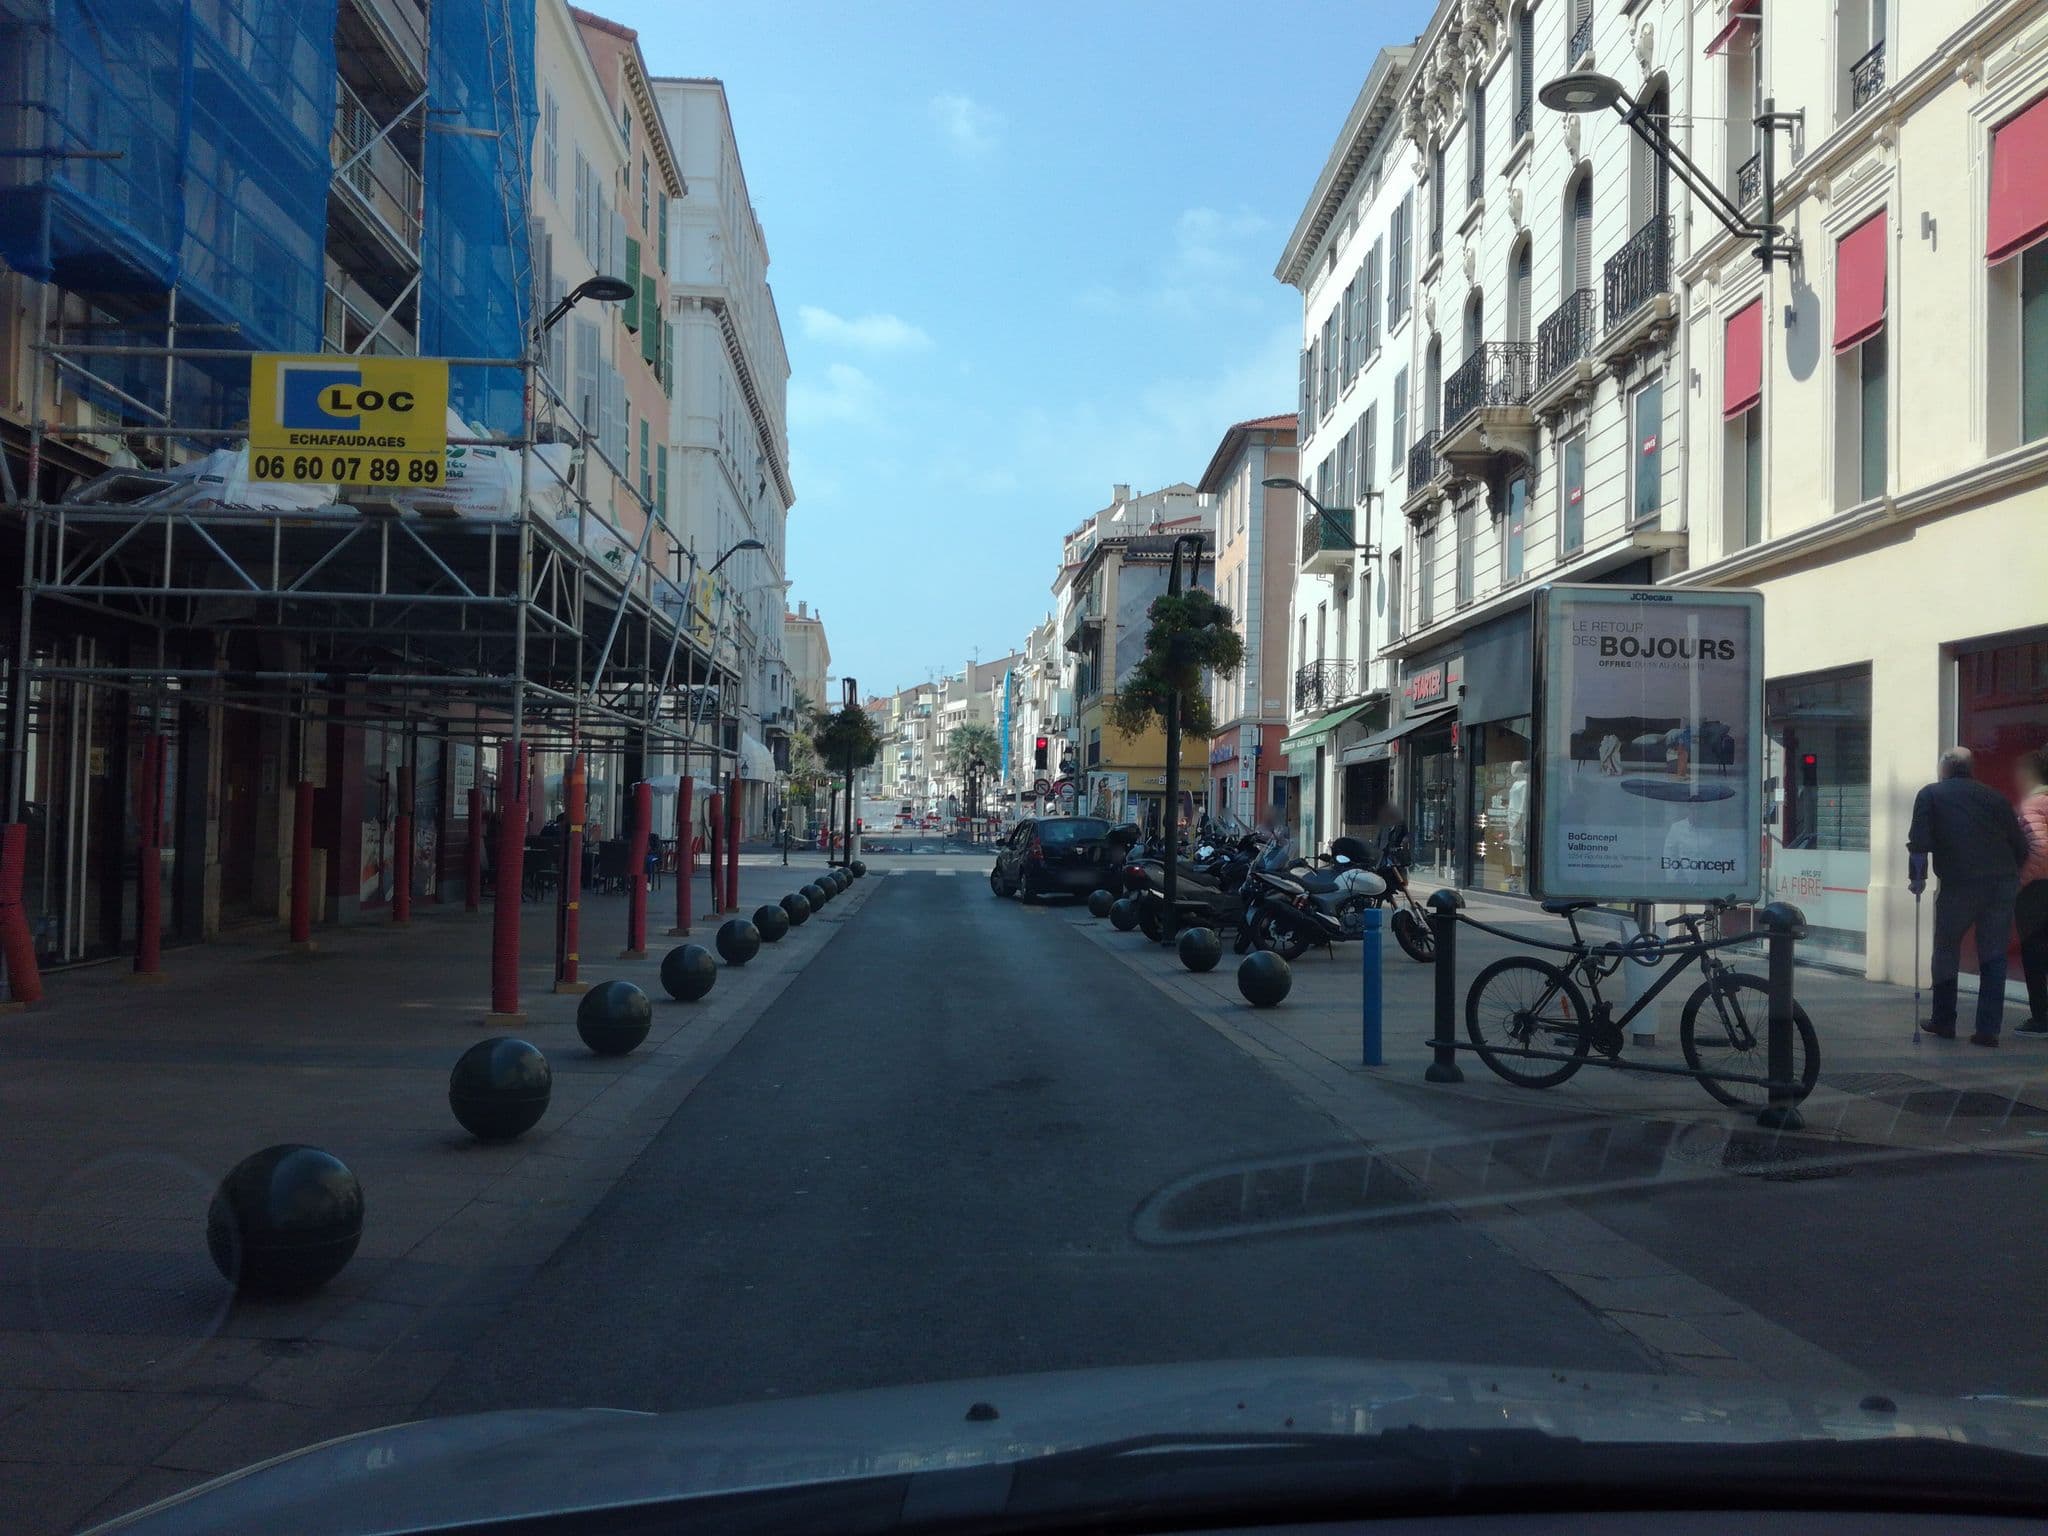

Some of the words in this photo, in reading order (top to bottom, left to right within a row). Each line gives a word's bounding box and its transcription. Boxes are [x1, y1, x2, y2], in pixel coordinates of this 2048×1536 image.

[289, 433, 406, 448] ECHAFAUDAGES
[254, 455, 285, 480] 06
[293, 456, 323, 480] 60
[331, 457, 361, 481] 07
[369, 458, 400, 482] 89
[408, 459, 439, 484] 89
[1630, 592, 1673, 602] JCDecaux
[1571, 620, 1588, 632] LE
[1591, 620, 1644, 633] RETOUR
[1571, 635, 1598, 647] DES
[1600, 636, 1736, 661] BOJOURS
[1598, 660, 1633, 668] OFFRES
[1412, 669, 1441, 702] STARTER
[1568, 832, 1618, 842] BoConcept
[1567, 842, 1609, 852] Valbonne
[1660, 856, 1736, 874] BoConcept
[1775, 875, 1788, 894] LA
[1792, 876, 1822, 897] FIBRE
